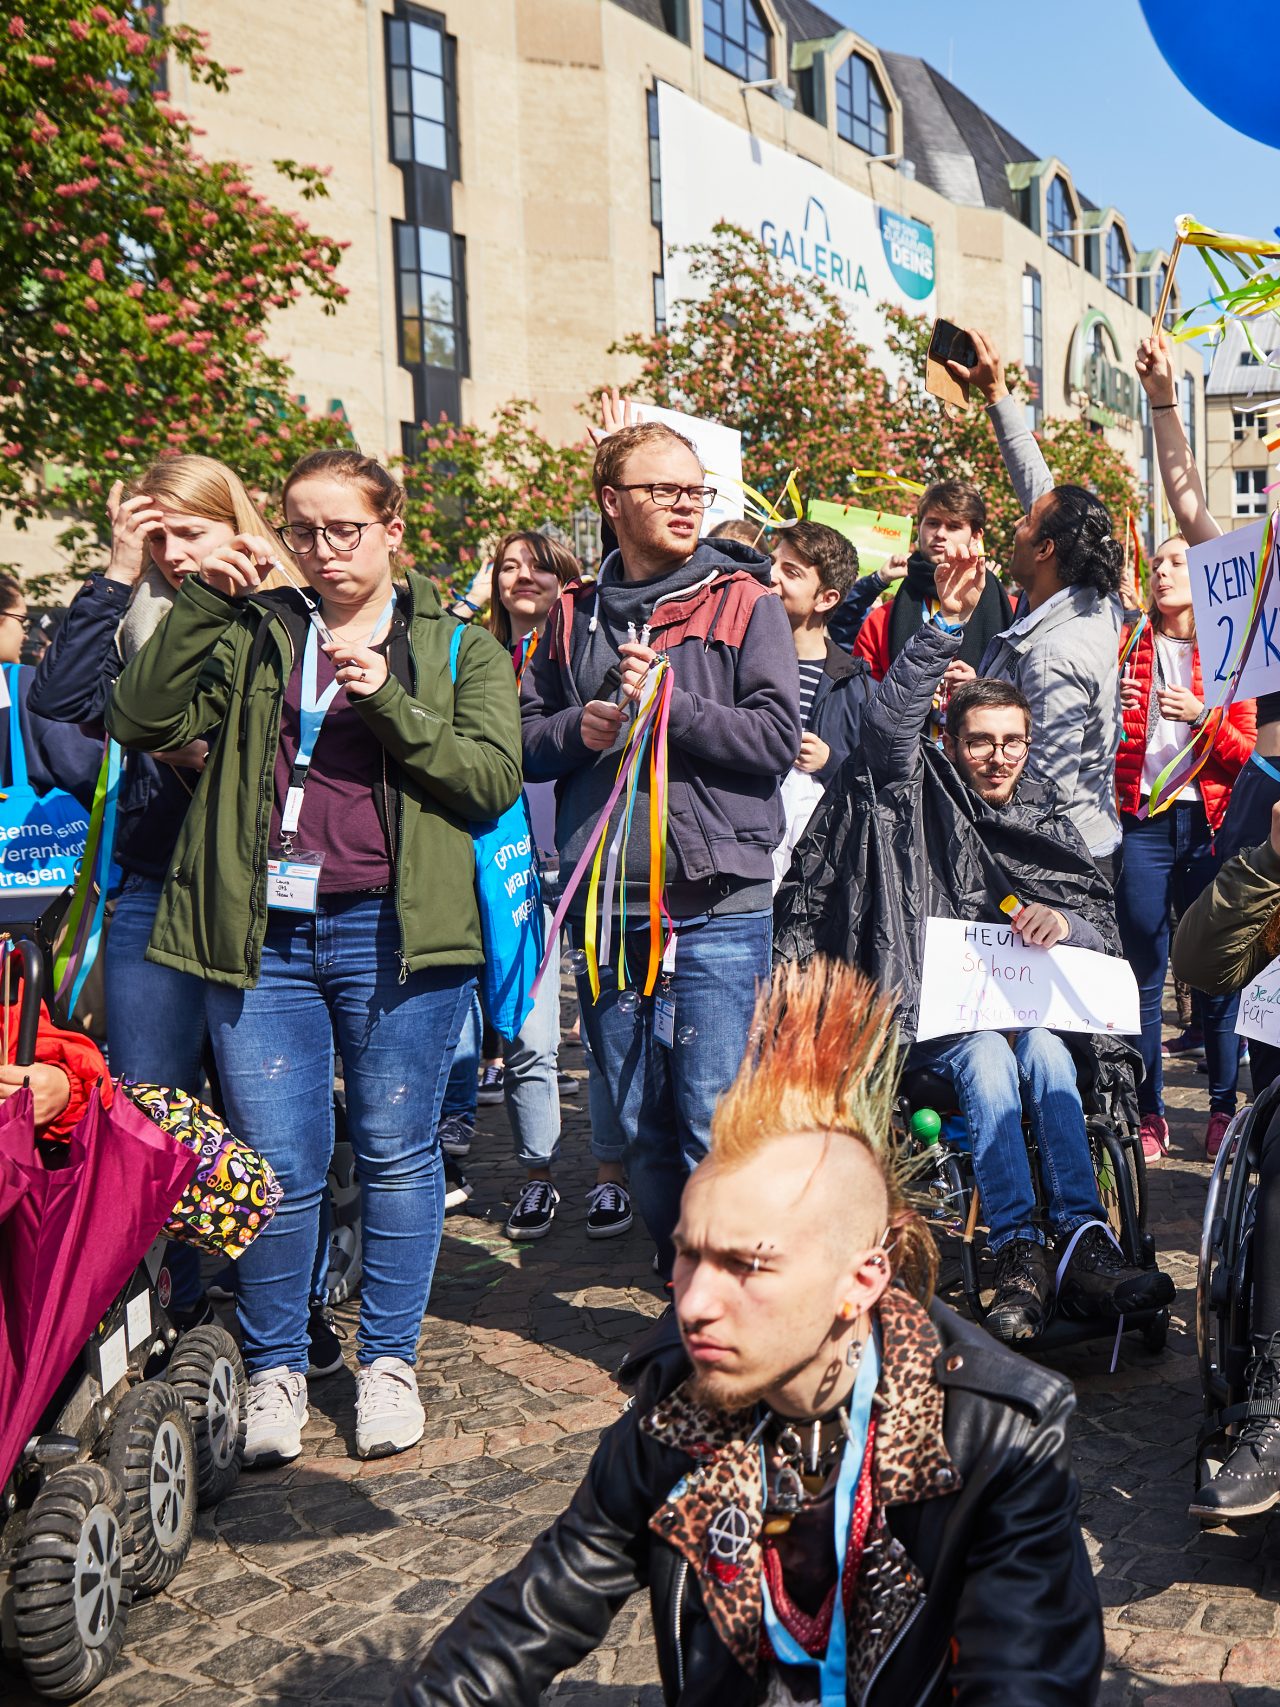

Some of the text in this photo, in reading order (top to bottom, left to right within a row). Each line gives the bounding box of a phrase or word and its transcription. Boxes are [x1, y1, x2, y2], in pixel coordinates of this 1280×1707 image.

[761, 220, 869, 297] GALERIA
[891, 242, 934, 281] DEINS
[1204, 551, 1255, 607] KEIN
[0, 866, 66, 887] tragen
[1242, 1000, 1274, 1029] für
